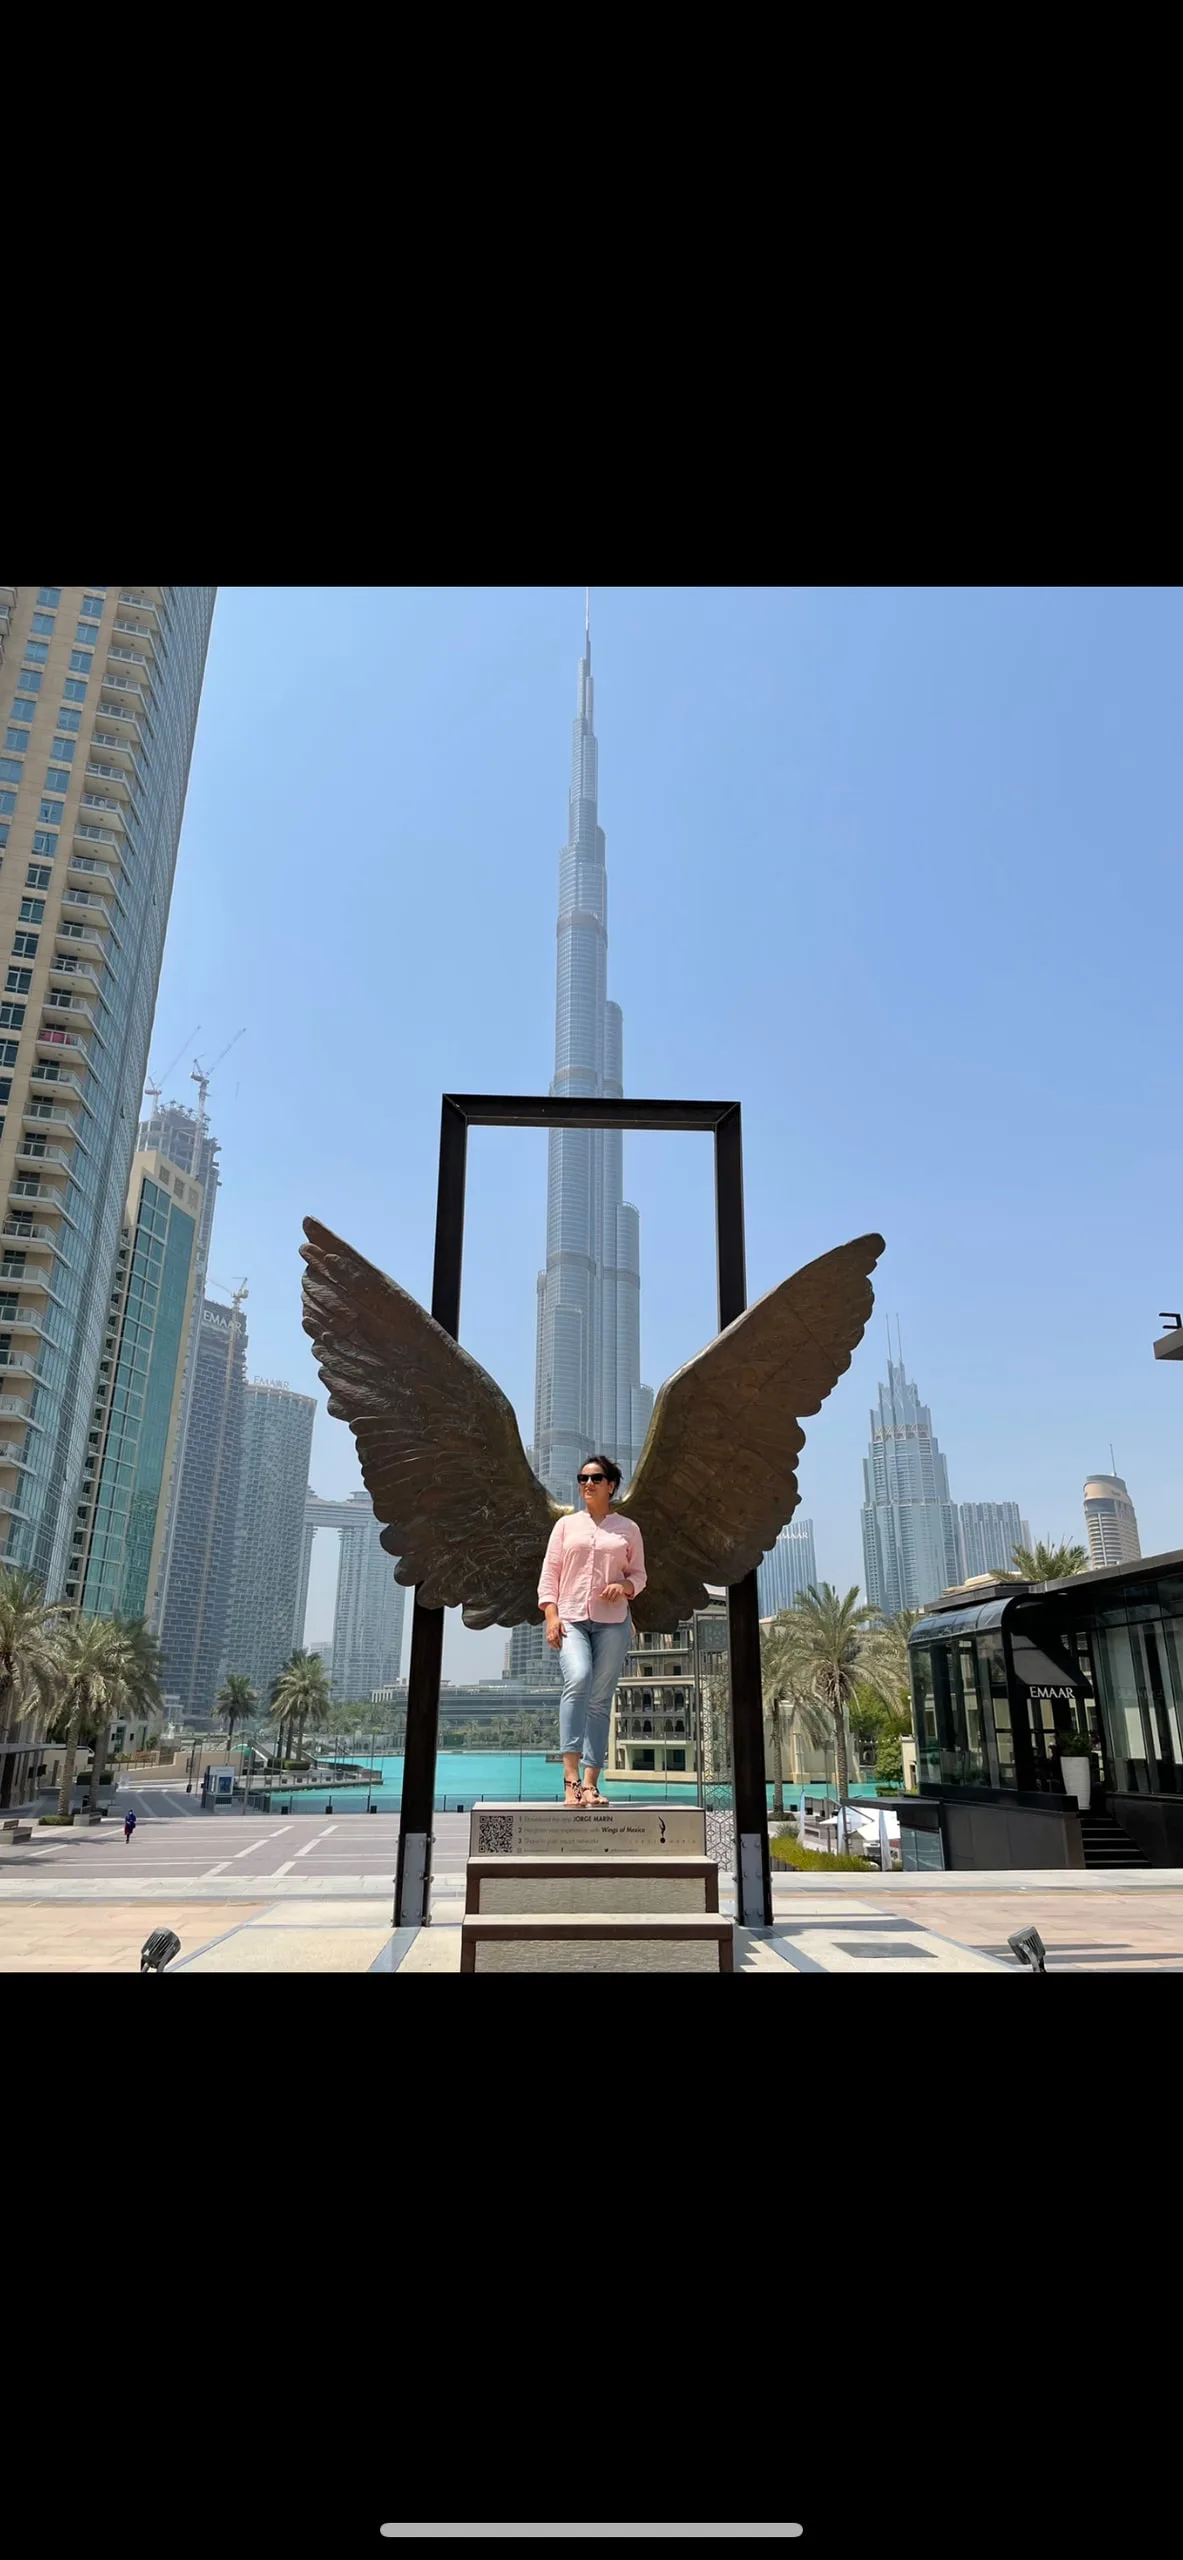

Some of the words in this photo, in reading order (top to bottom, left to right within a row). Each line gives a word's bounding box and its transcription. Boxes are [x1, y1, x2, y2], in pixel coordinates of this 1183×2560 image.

[1029, 1686, 1075, 1699] EMAAR
[601, 1826, 618, 1835] Wings
[619, 1825, 626, 1833] of
